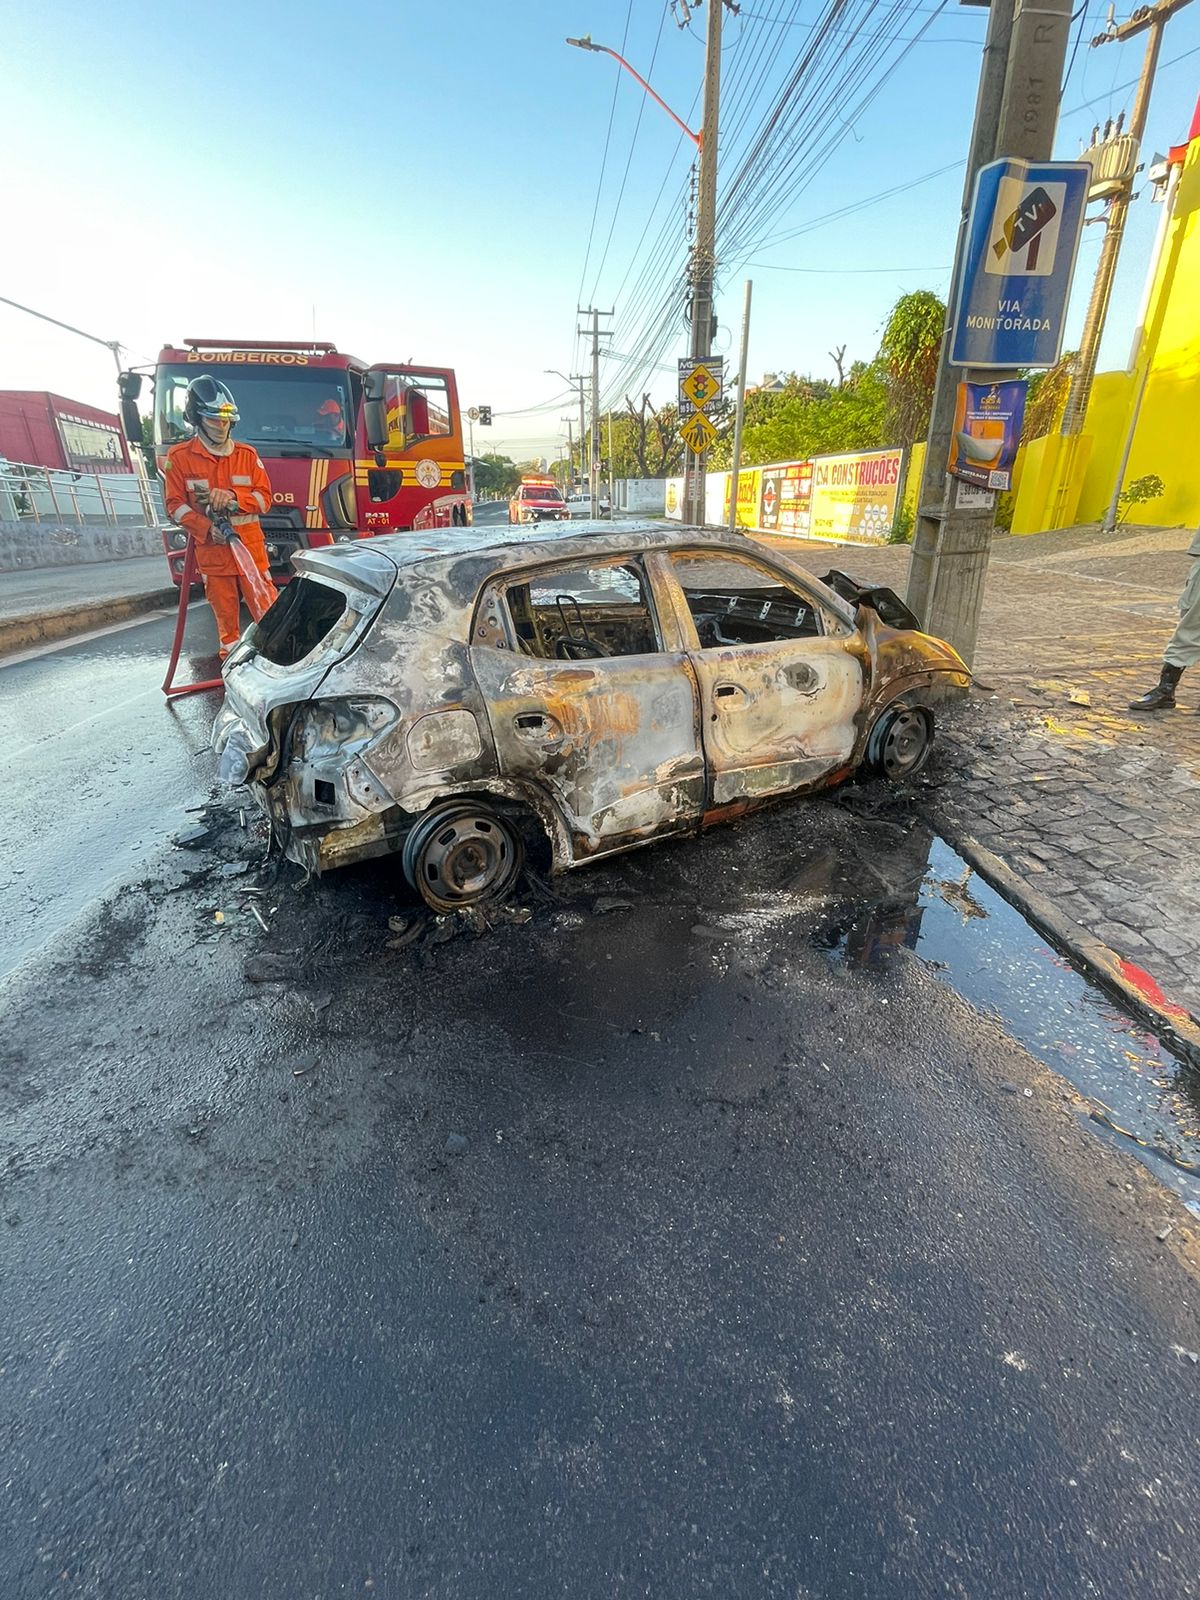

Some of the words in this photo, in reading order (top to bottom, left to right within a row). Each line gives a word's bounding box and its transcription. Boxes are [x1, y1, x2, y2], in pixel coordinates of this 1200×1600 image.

[1014, 204, 1038, 232] TV
[998, 300, 1021, 312] VIA
[966, 316, 1051, 331] MONITORADA
[187, 352, 309, 366] BOMBEIROS
[831, 456, 900, 488] CONSTRUÇÕES
